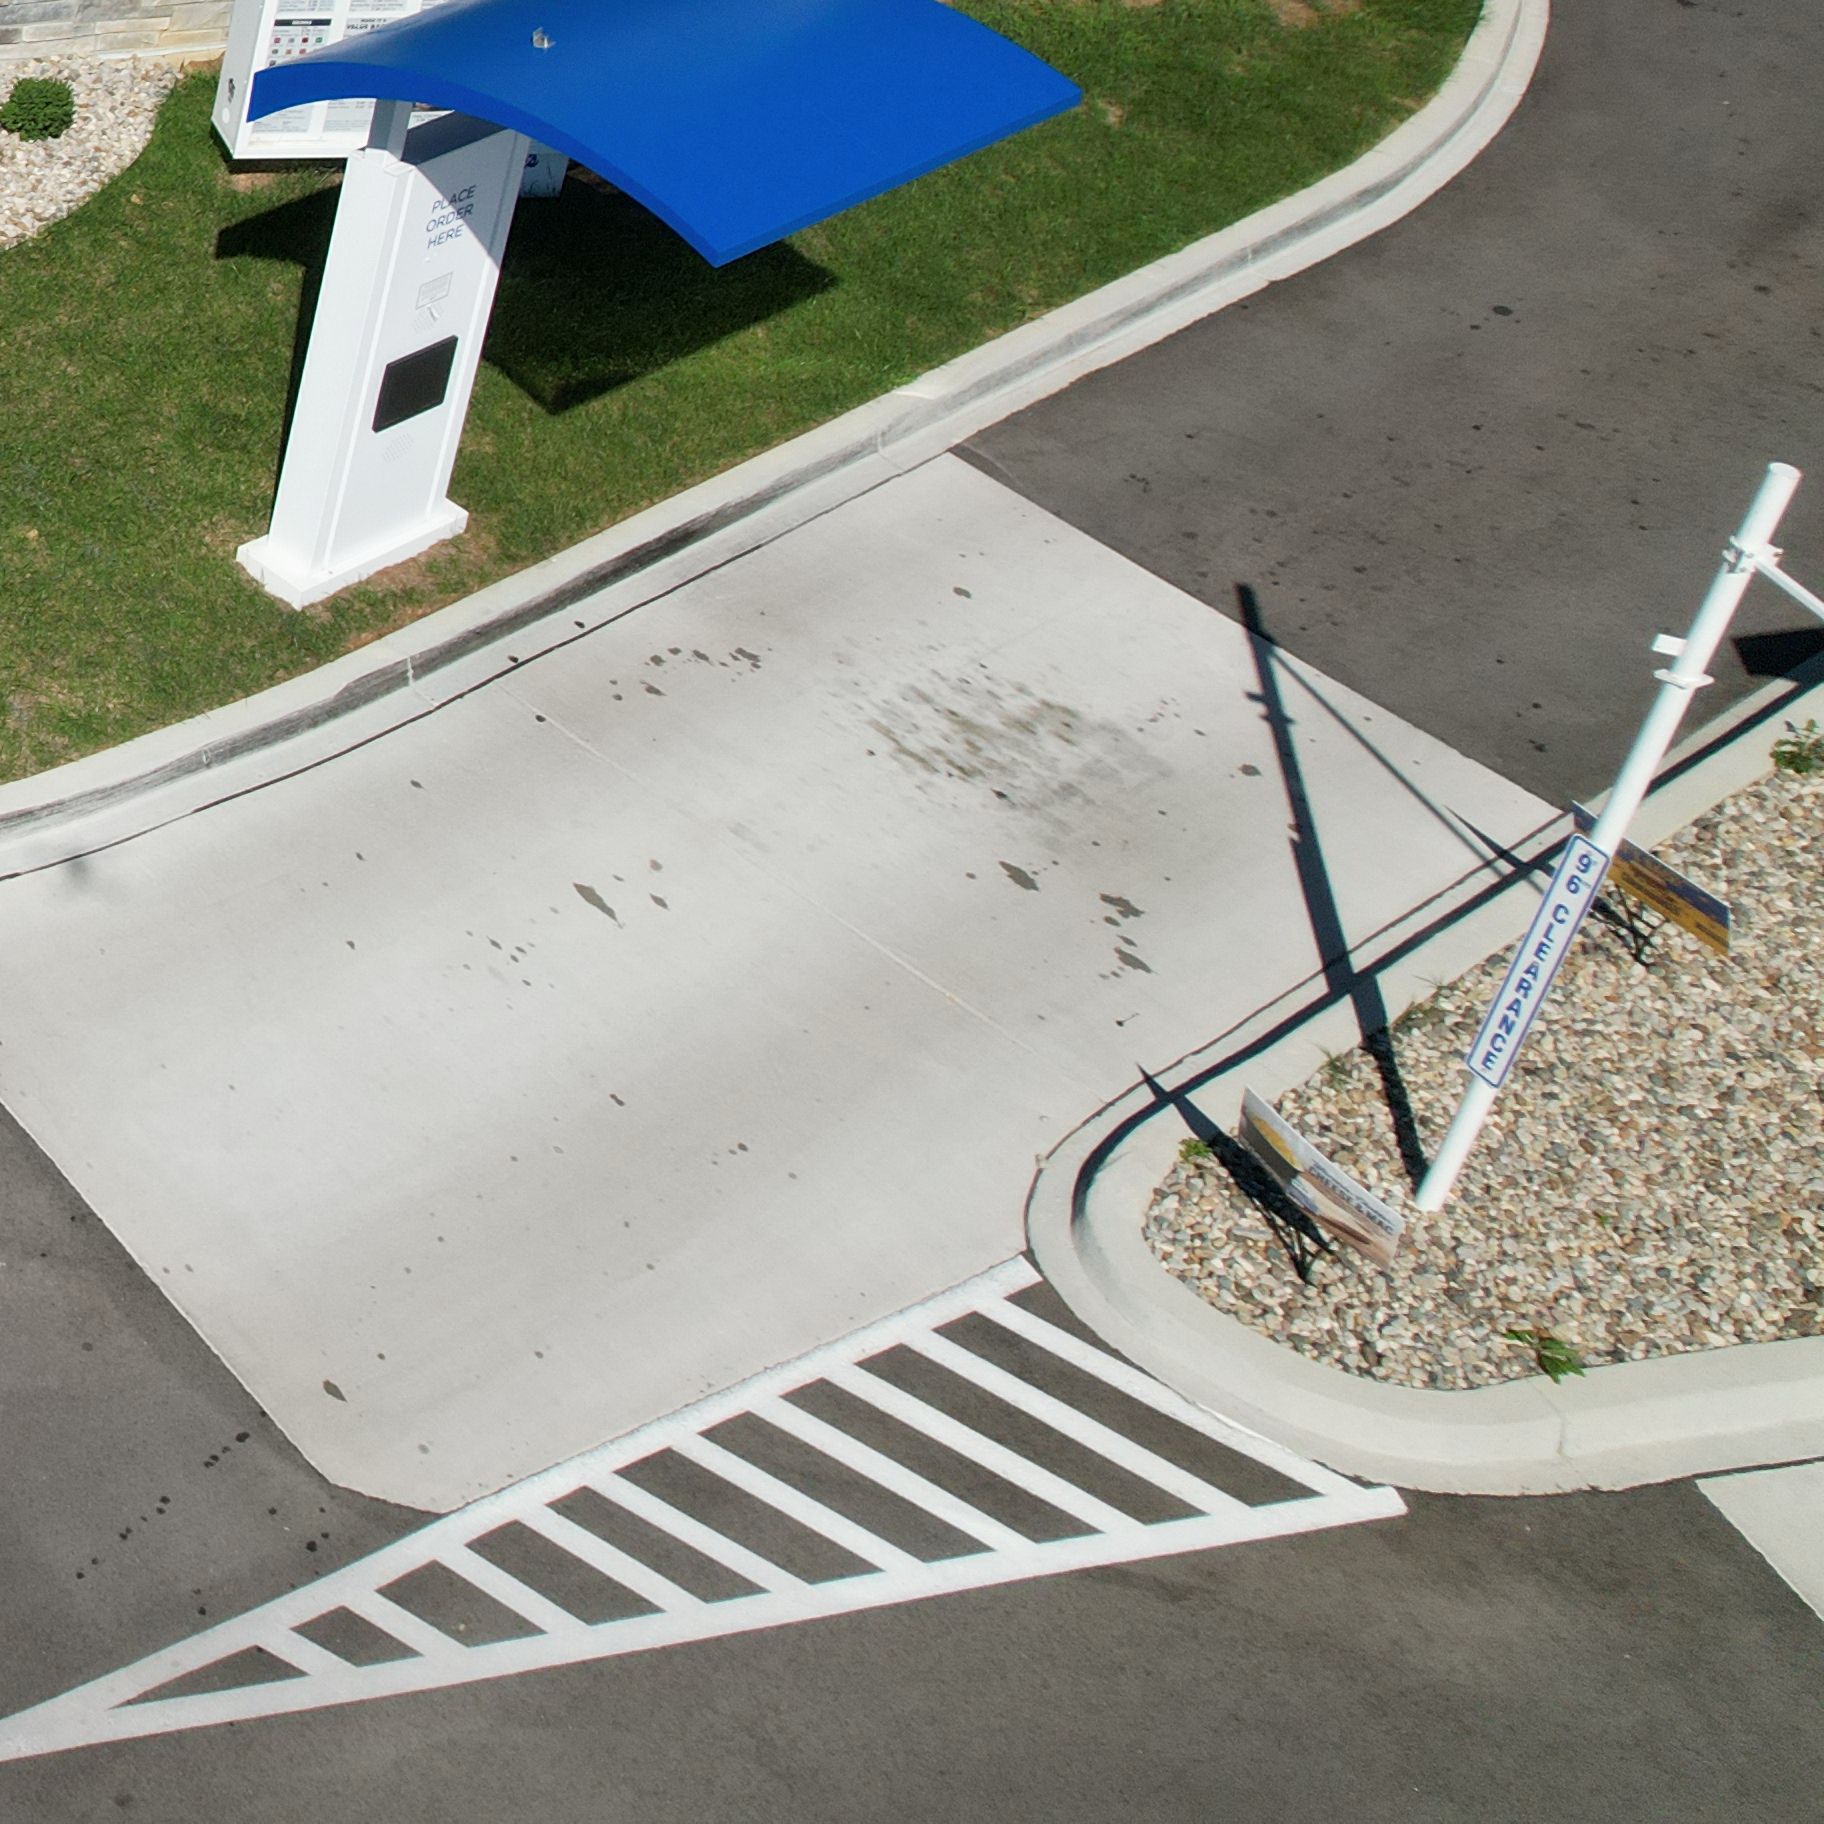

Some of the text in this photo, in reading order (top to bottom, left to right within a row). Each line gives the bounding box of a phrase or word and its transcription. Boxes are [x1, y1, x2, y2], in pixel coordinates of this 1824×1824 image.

[432, 184, 477, 213] PLACE
[426, 203, 474, 233] ORDER
[427, 224, 464, 249] HERE
[1481, 903, 1570, 1071] CLEARANCE
